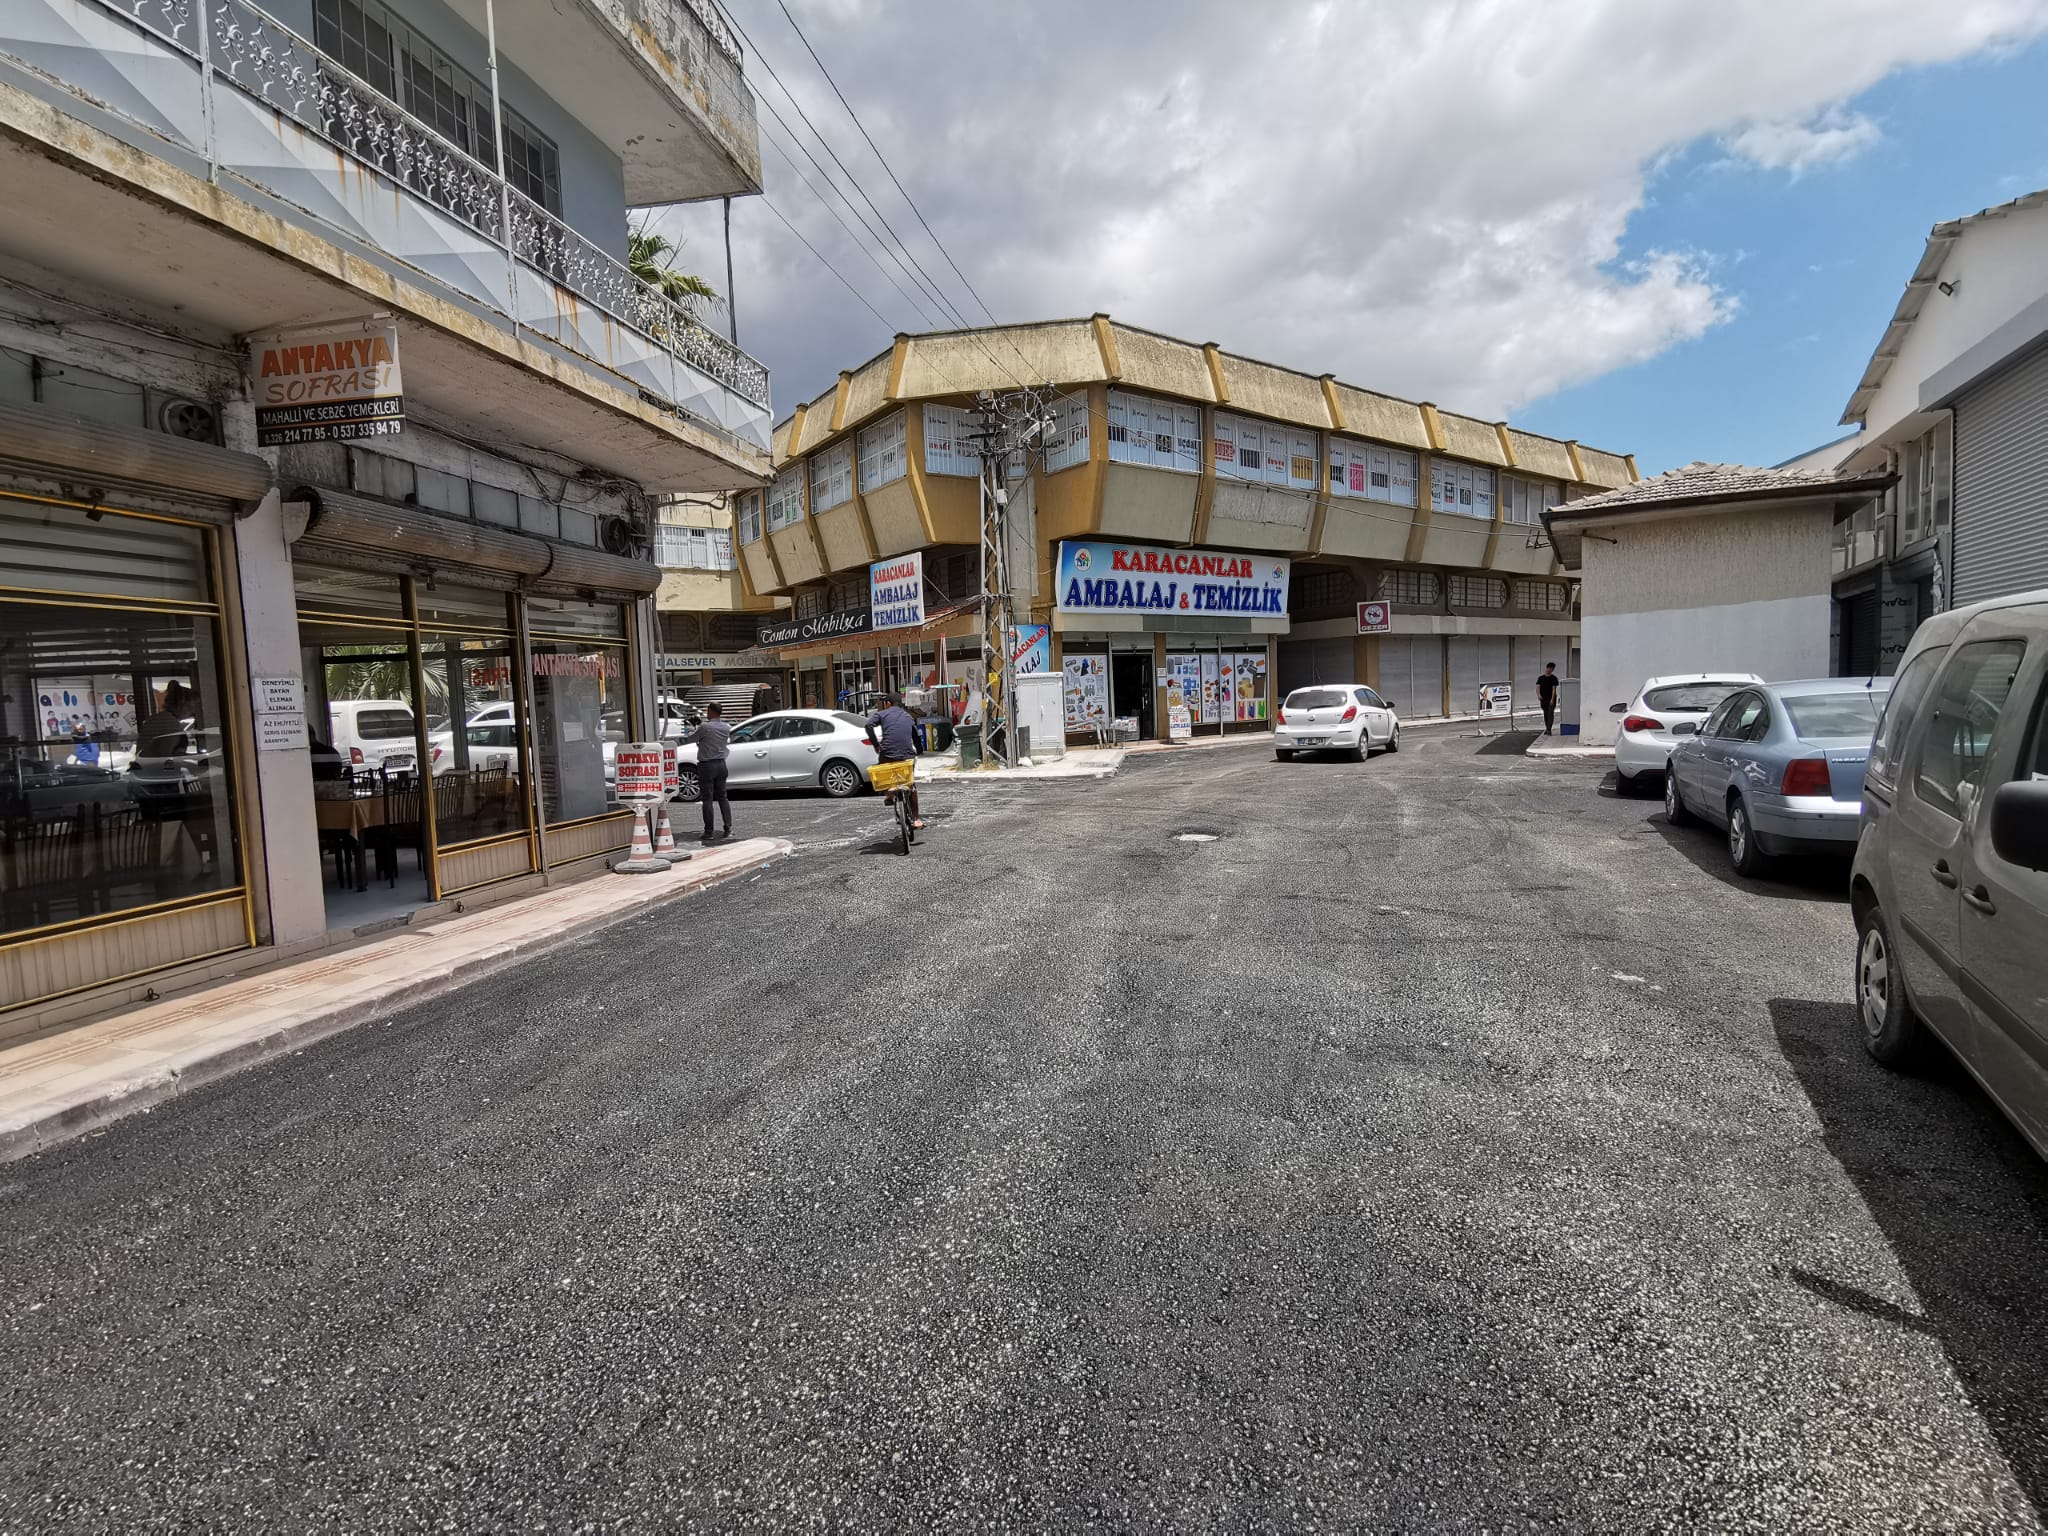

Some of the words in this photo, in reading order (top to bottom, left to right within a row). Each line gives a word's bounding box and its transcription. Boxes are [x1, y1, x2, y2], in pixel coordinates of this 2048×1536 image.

[260, 336, 393, 378] ANTAKYA
[265, 367, 392, 404] SOFRASI
[262, 408, 302, 425] MAHALLİ
[303, 407, 317, 421] VE
[317, 405, 346, 421] SEBZE
[347, 397, 400, 417] YEMEKLERİ
[284, 429, 300, 443] 214
[301, 428, 313, 441] 77
[314, 427, 326, 440] 95
[332, 426, 339, 439] 0
[340, 424, 356, 437] 537
[358, 422, 375, 436] 335
[376, 421, 388, 435] 94
[388, 420, 401, 434] 79
[873, 560, 915, 585] KARACANLAR
[1111, 550, 1254, 579] KARACANLAR
[873, 581, 919, 607] AMBALAJ
[1064, 576, 1178, 610] AMBALAJ
[1179, 591, 1190, 610] &
[1192, 579, 1283, 613] TEMİZLİK
[874, 602, 920, 628] TEMİZLİK
[760, 626, 799, 645] Tonton
[801, 612, 867, 639] Mobilya
[533, 652, 581, 677] ANTAKYA
[582, 655, 621, 678] SOFRASI
[617, 752, 660, 765] ANTAKYA
[618, 765, 660, 777] SOFRASI
